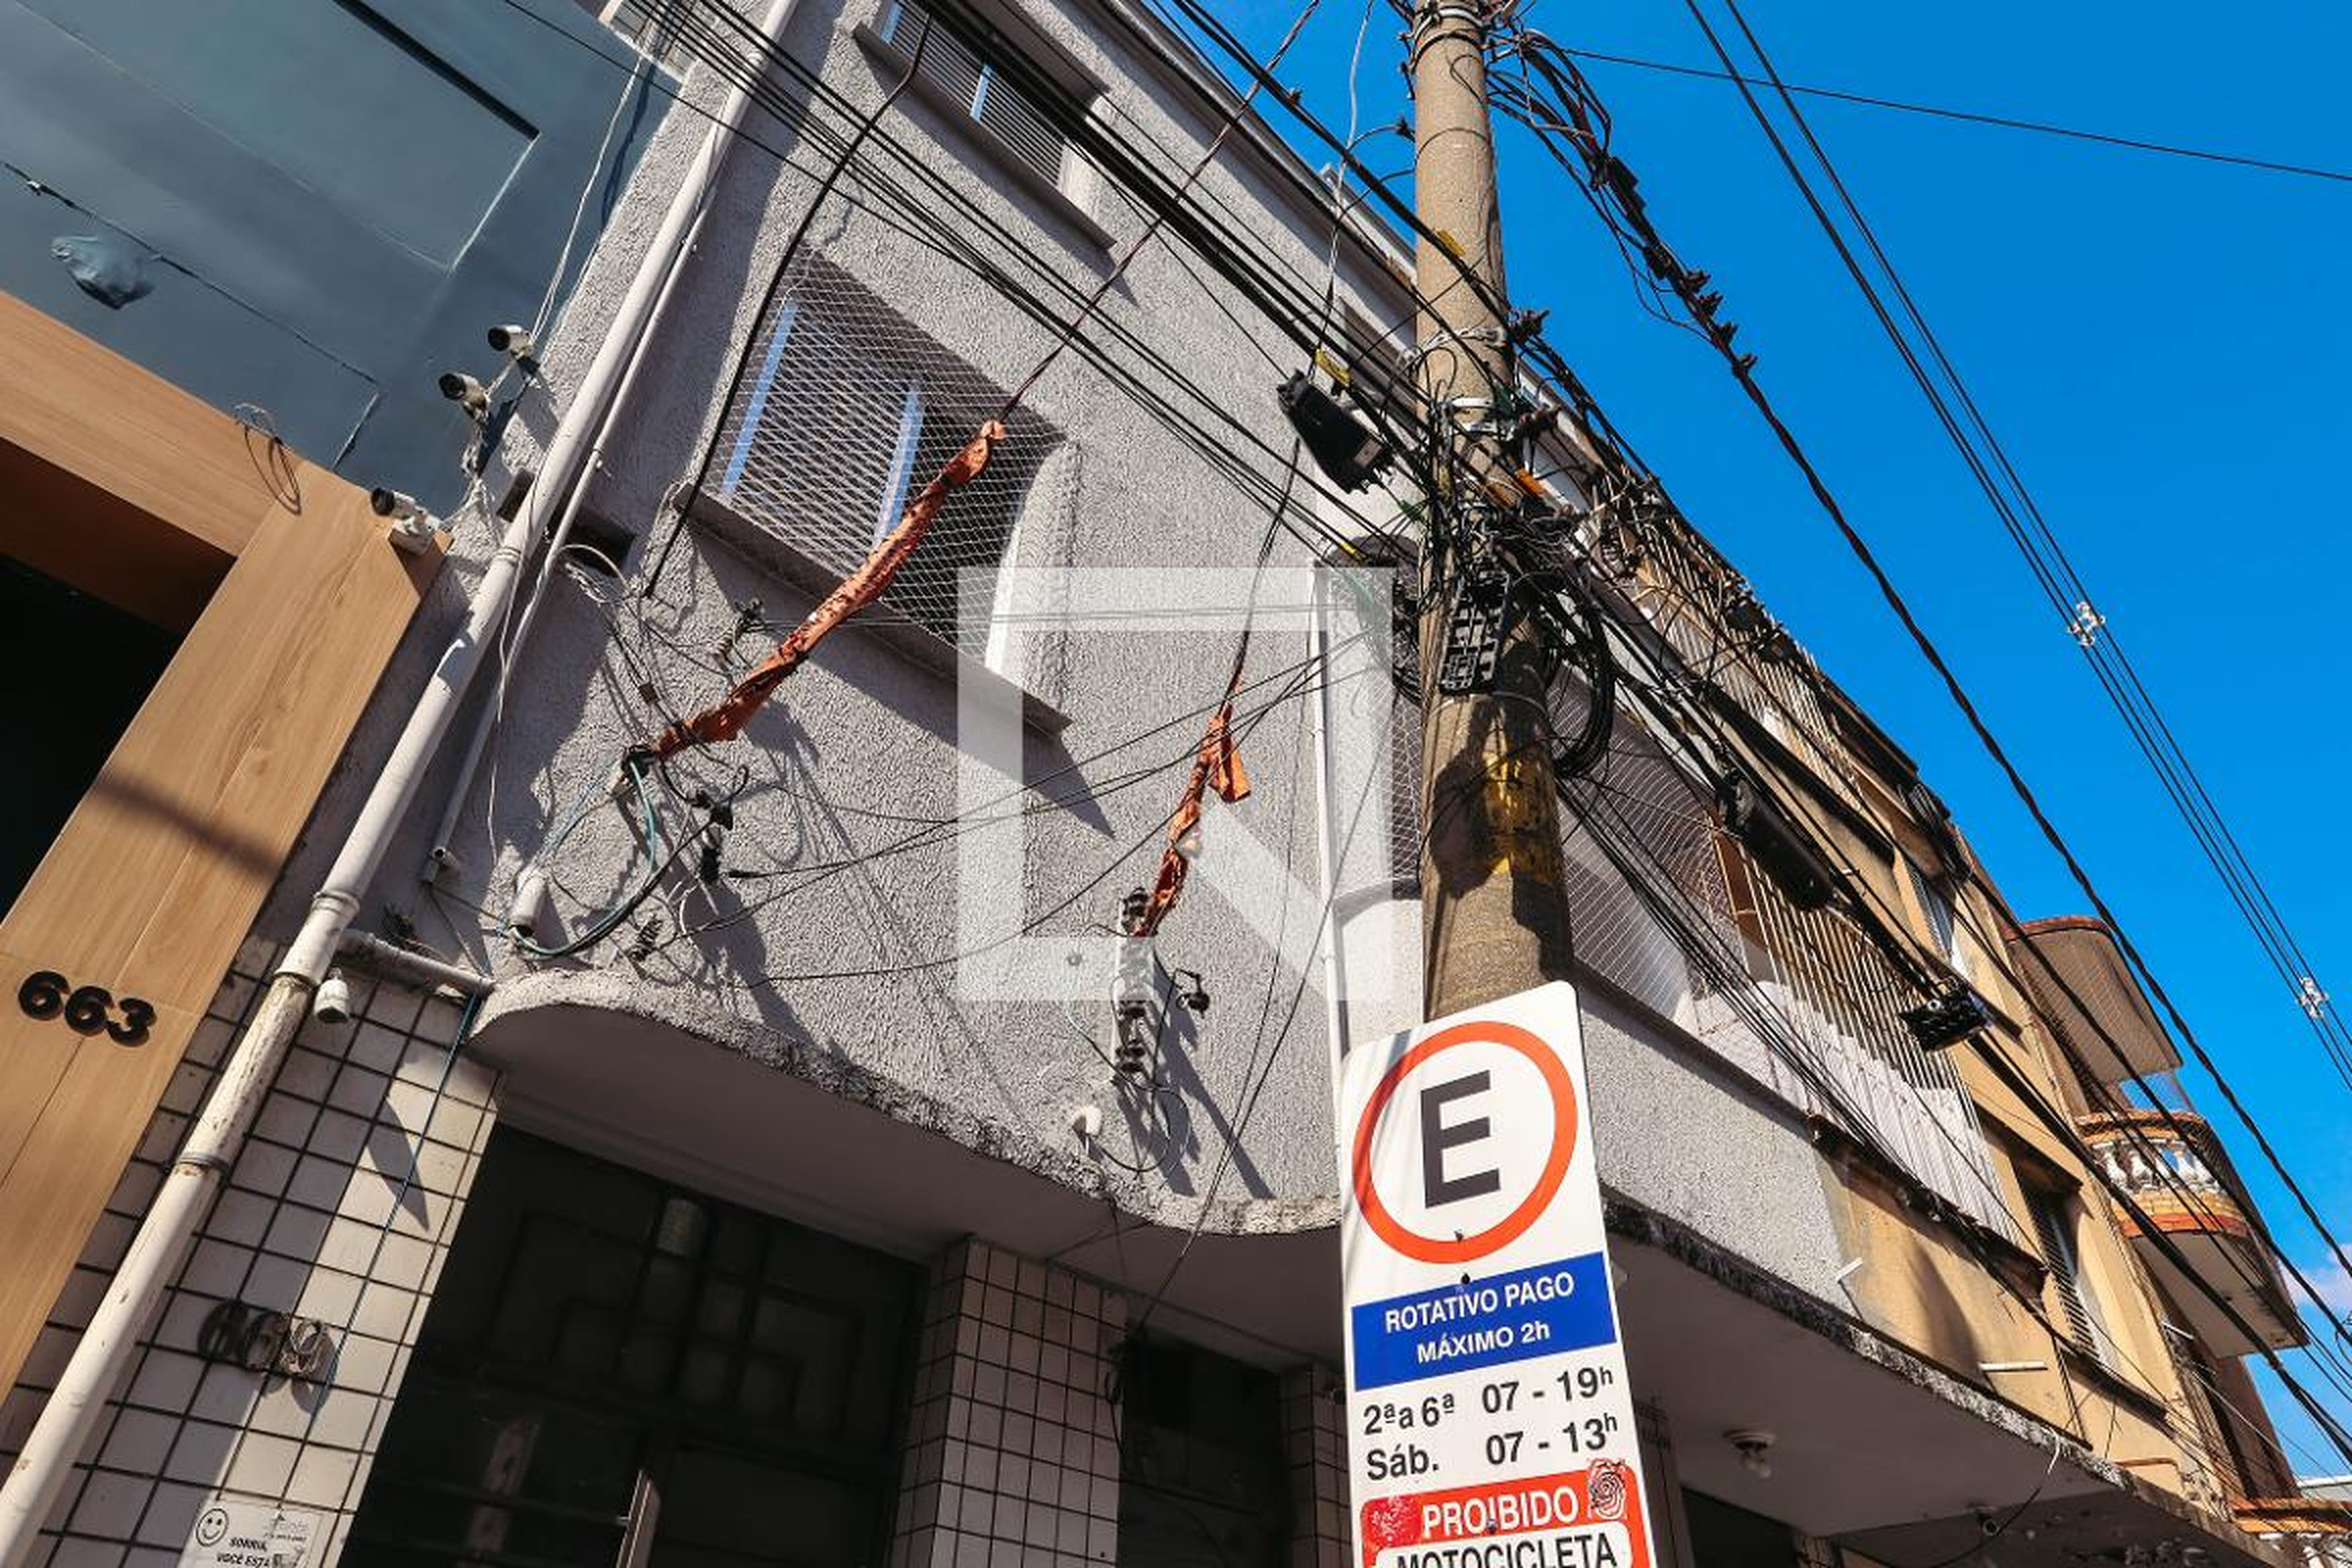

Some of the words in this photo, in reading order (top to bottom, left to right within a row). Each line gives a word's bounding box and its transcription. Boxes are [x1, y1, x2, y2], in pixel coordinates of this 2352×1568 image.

[18, 971, 157, 1047] 663
[1420, 1069, 1501, 1209] E
[1385, 1289, 1498, 1334] ROTATIVO
[1504, 1272, 1575, 1307] PAGO
[1417, 1326, 1514, 1364] MÁXIMO
[1520, 1321, 1550, 1344] 2h
[1482, 1382, 1520, 1414] 07
[1366, 1444, 1439, 1481] Sáb.
[1486, 1431, 1524, 1465] 07
[1422, 1485, 1580, 1539] PROIBIDO
